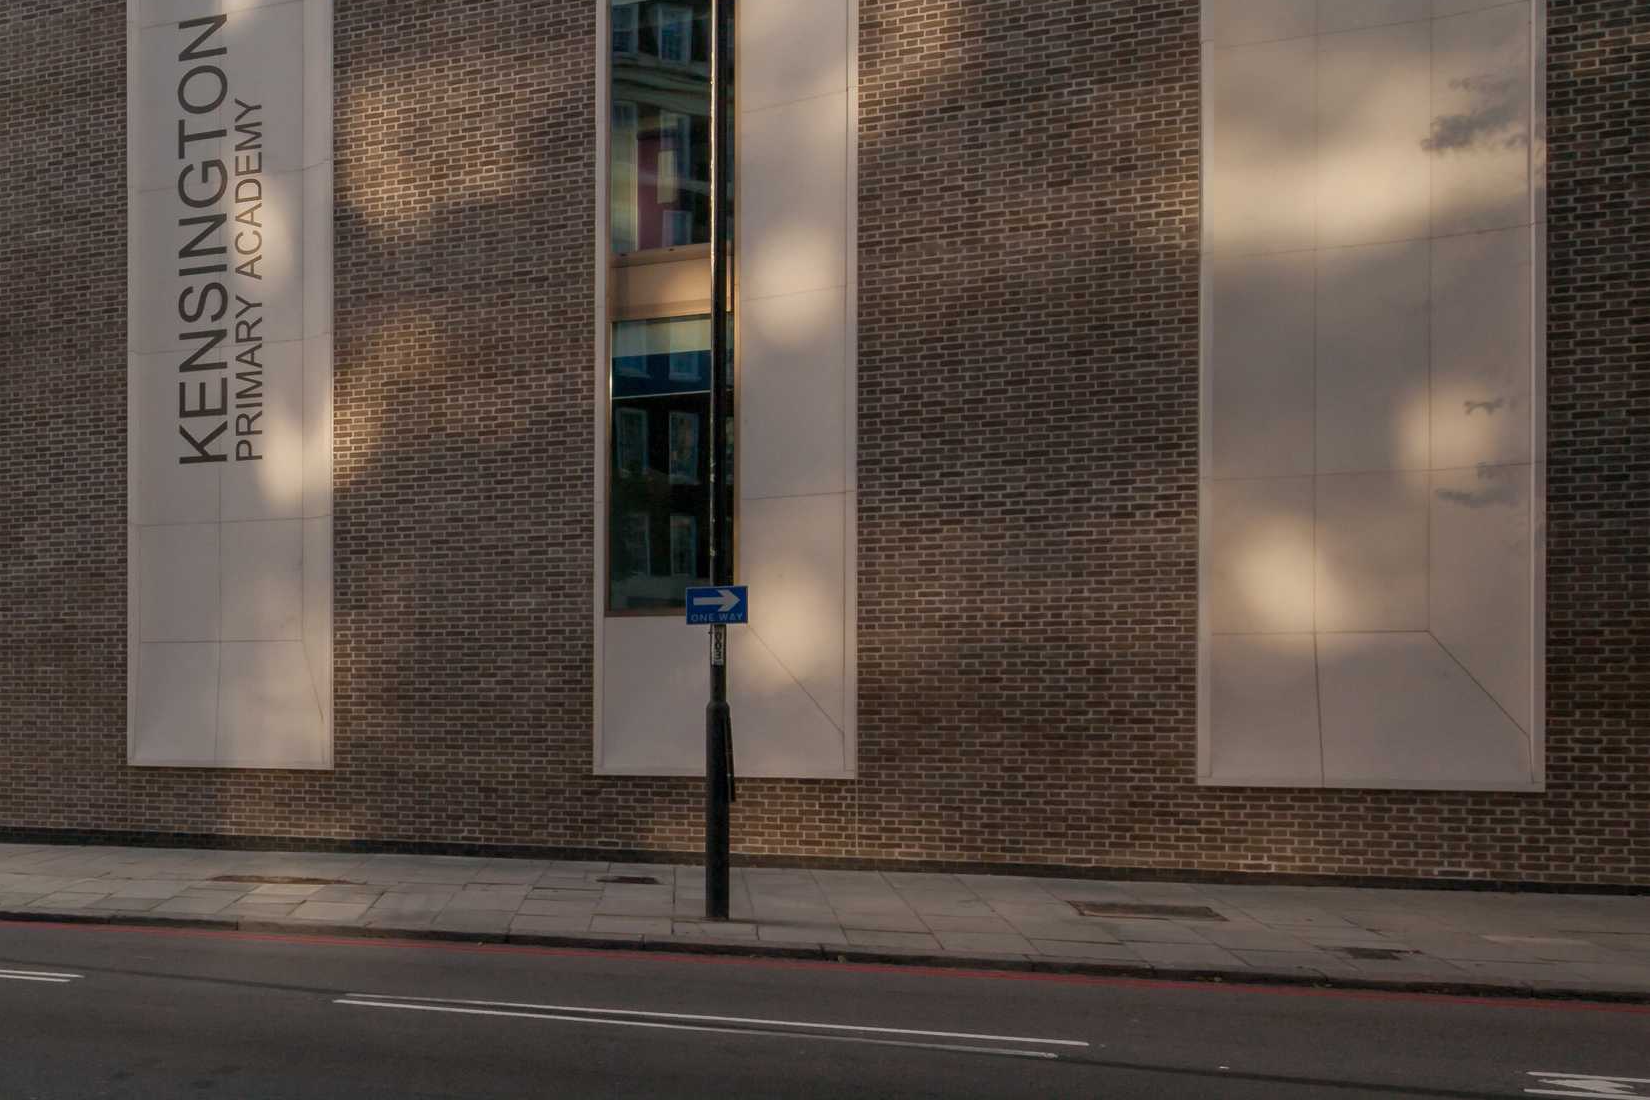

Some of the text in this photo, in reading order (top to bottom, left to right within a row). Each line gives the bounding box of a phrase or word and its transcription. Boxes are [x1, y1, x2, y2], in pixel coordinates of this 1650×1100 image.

[178, 14, 228, 464] KENSINGTON
[235, 98, 262, 461] PRIMARY ACADEMY
[690, 612, 743, 622] ONE WAY
